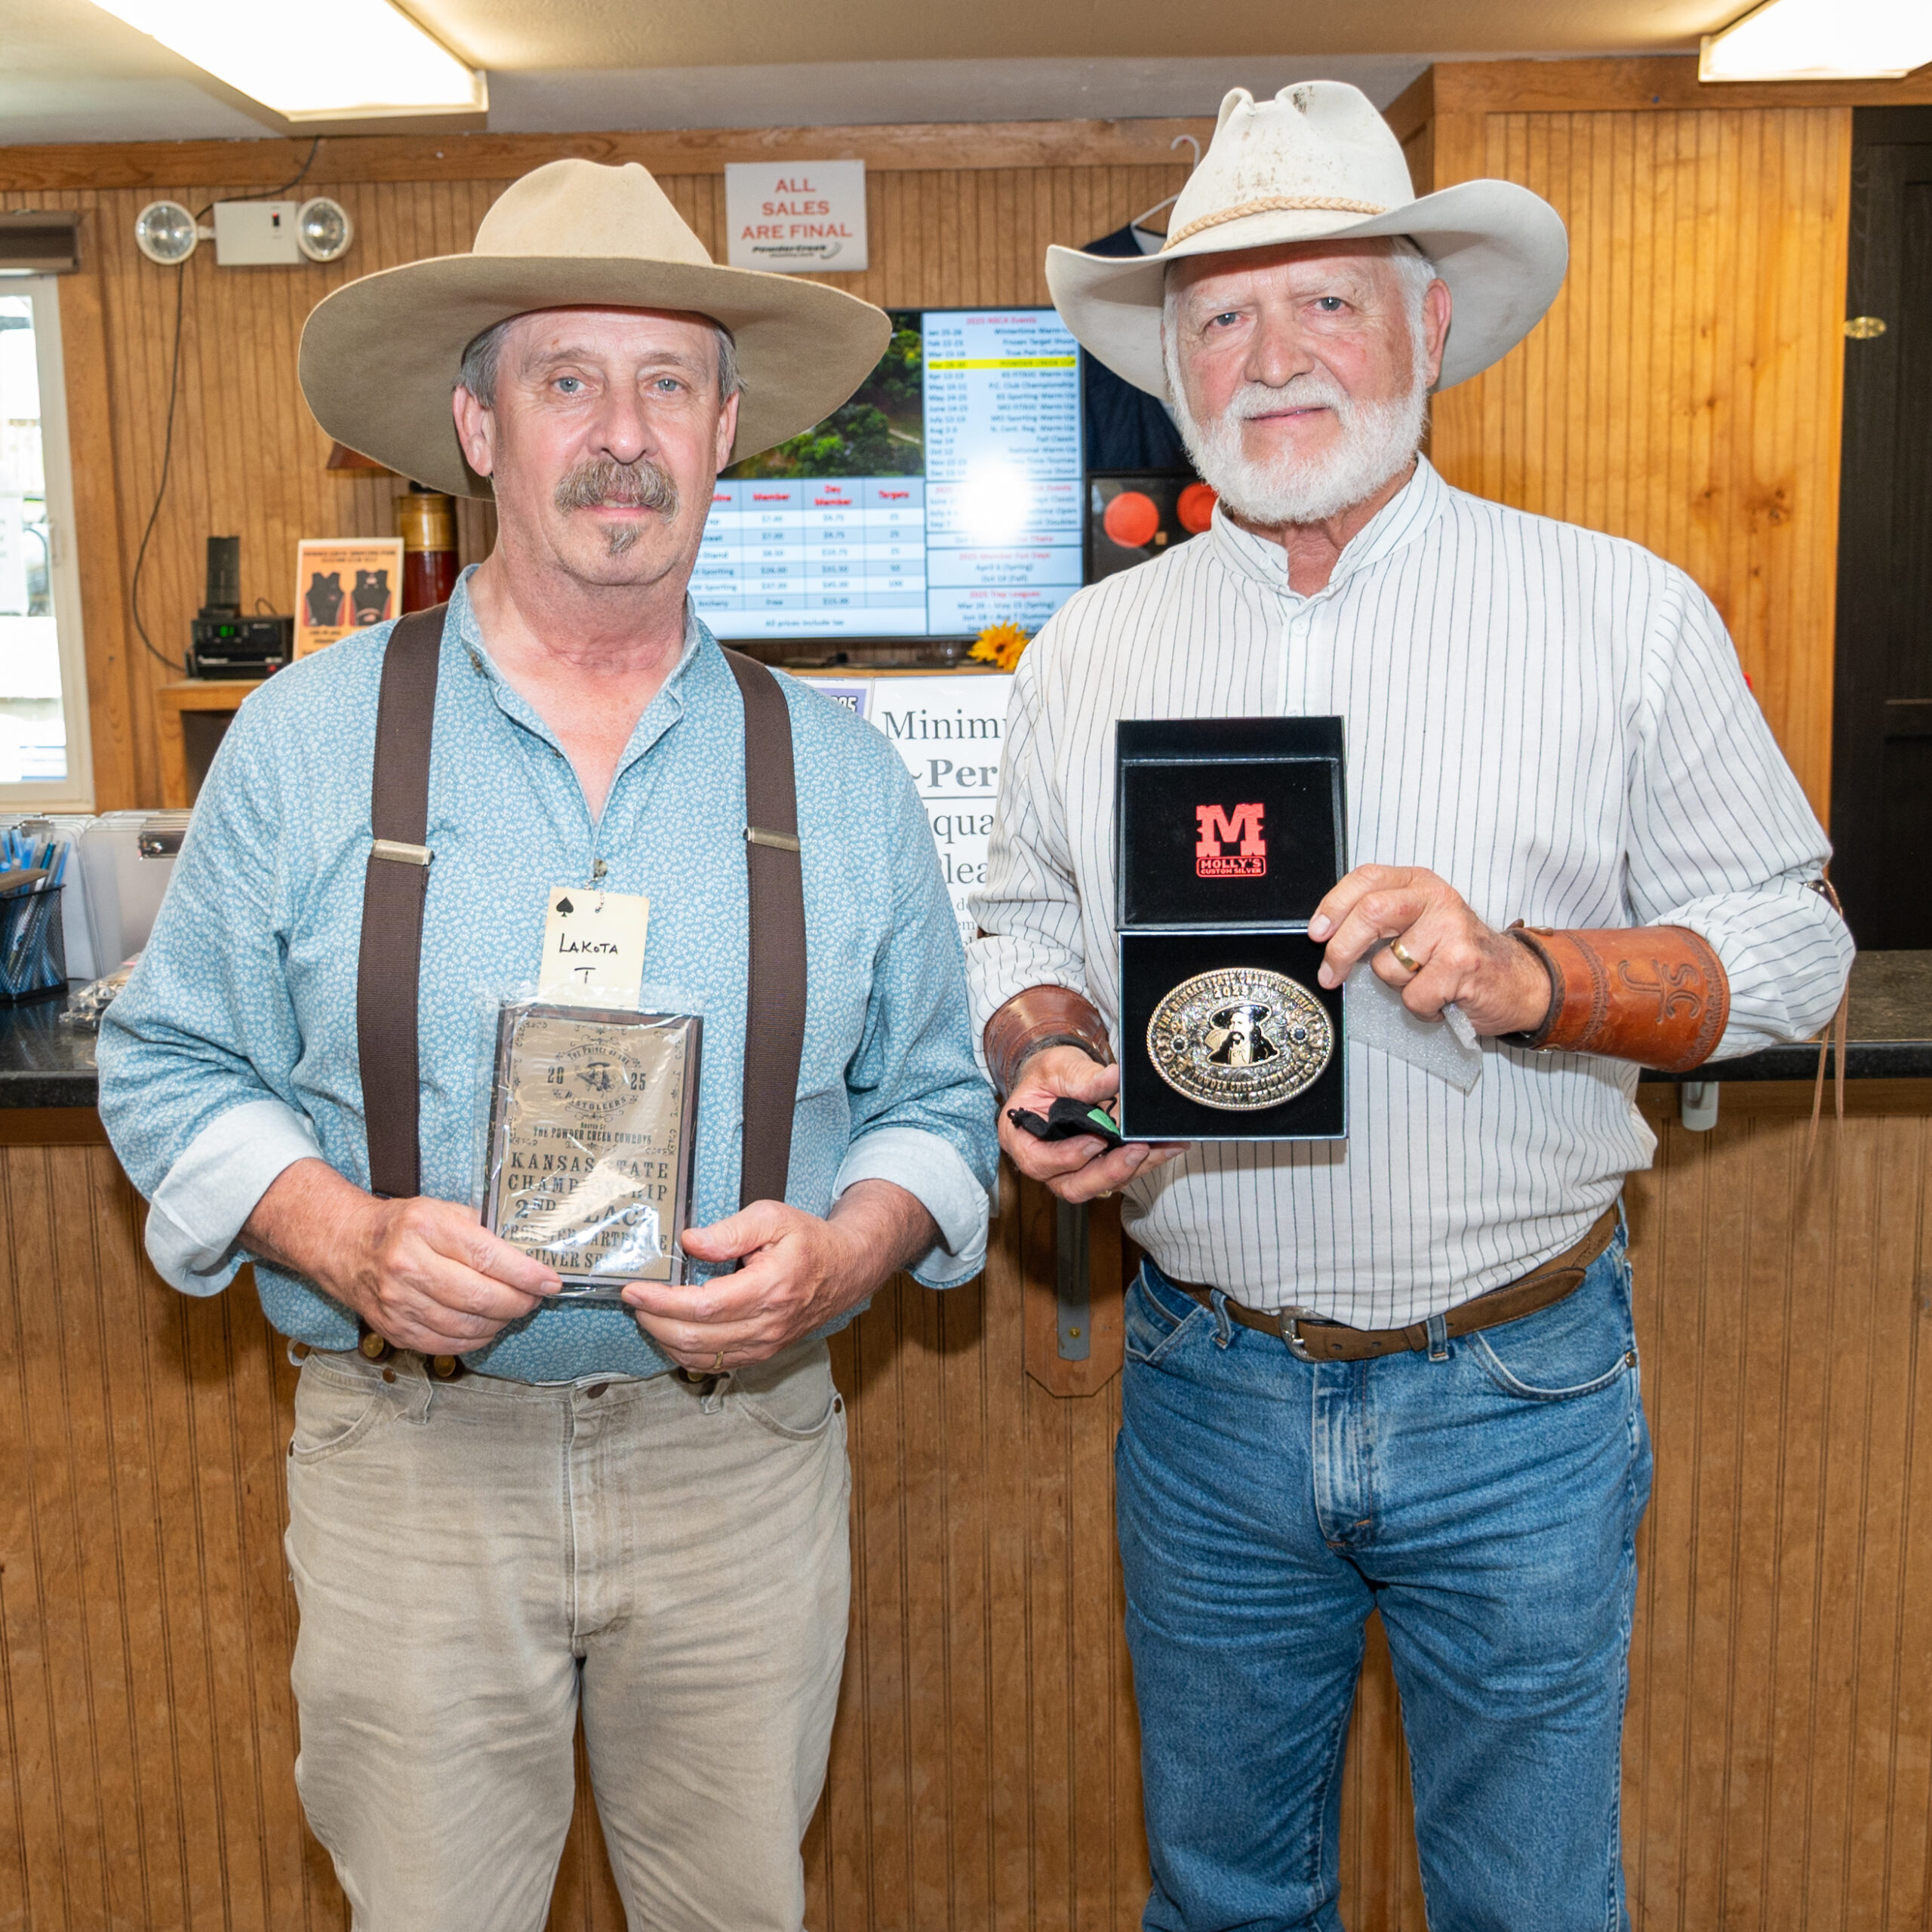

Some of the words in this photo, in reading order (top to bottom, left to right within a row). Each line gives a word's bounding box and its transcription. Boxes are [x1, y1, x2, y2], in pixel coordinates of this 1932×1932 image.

[774, 178, 817, 192] ALL
[761, 200, 830, 216] SALES
[741, 224, 784, 240] ARE
[789, 223, 853, 238] FINAL
[1023, 382, 1074, 390] Championship
[814, 498, 852, 506] Member
[878, 491, 909, 500] Targets
[928, 812, 995, 844] qua
[943, 854, 988, 884] lea
[1201, 858, 1261, 869] MOLLY'S
[1171, 982, 1205, 1011] KANSAS
[1239, 973, 1315, 1011] CHAMPIONSHIP
[1214, 986, 1250, 998] 2025
[547, 1066, 565, 1084] 20
[630, 1072, 646, 1091] 25
[1192, 1070, 1228, 1092] POWDER
[534, 1126, 548, 1138] THE
[552, 1127, 583, 1140] POWDER
[587, 1131, 611, 1143] CREEK
[614, 1132, 652, 1145] COWBOYS
[511, 1152, 595, 1173] KANSAS
[612, 1158, 669, 1179] TATE
